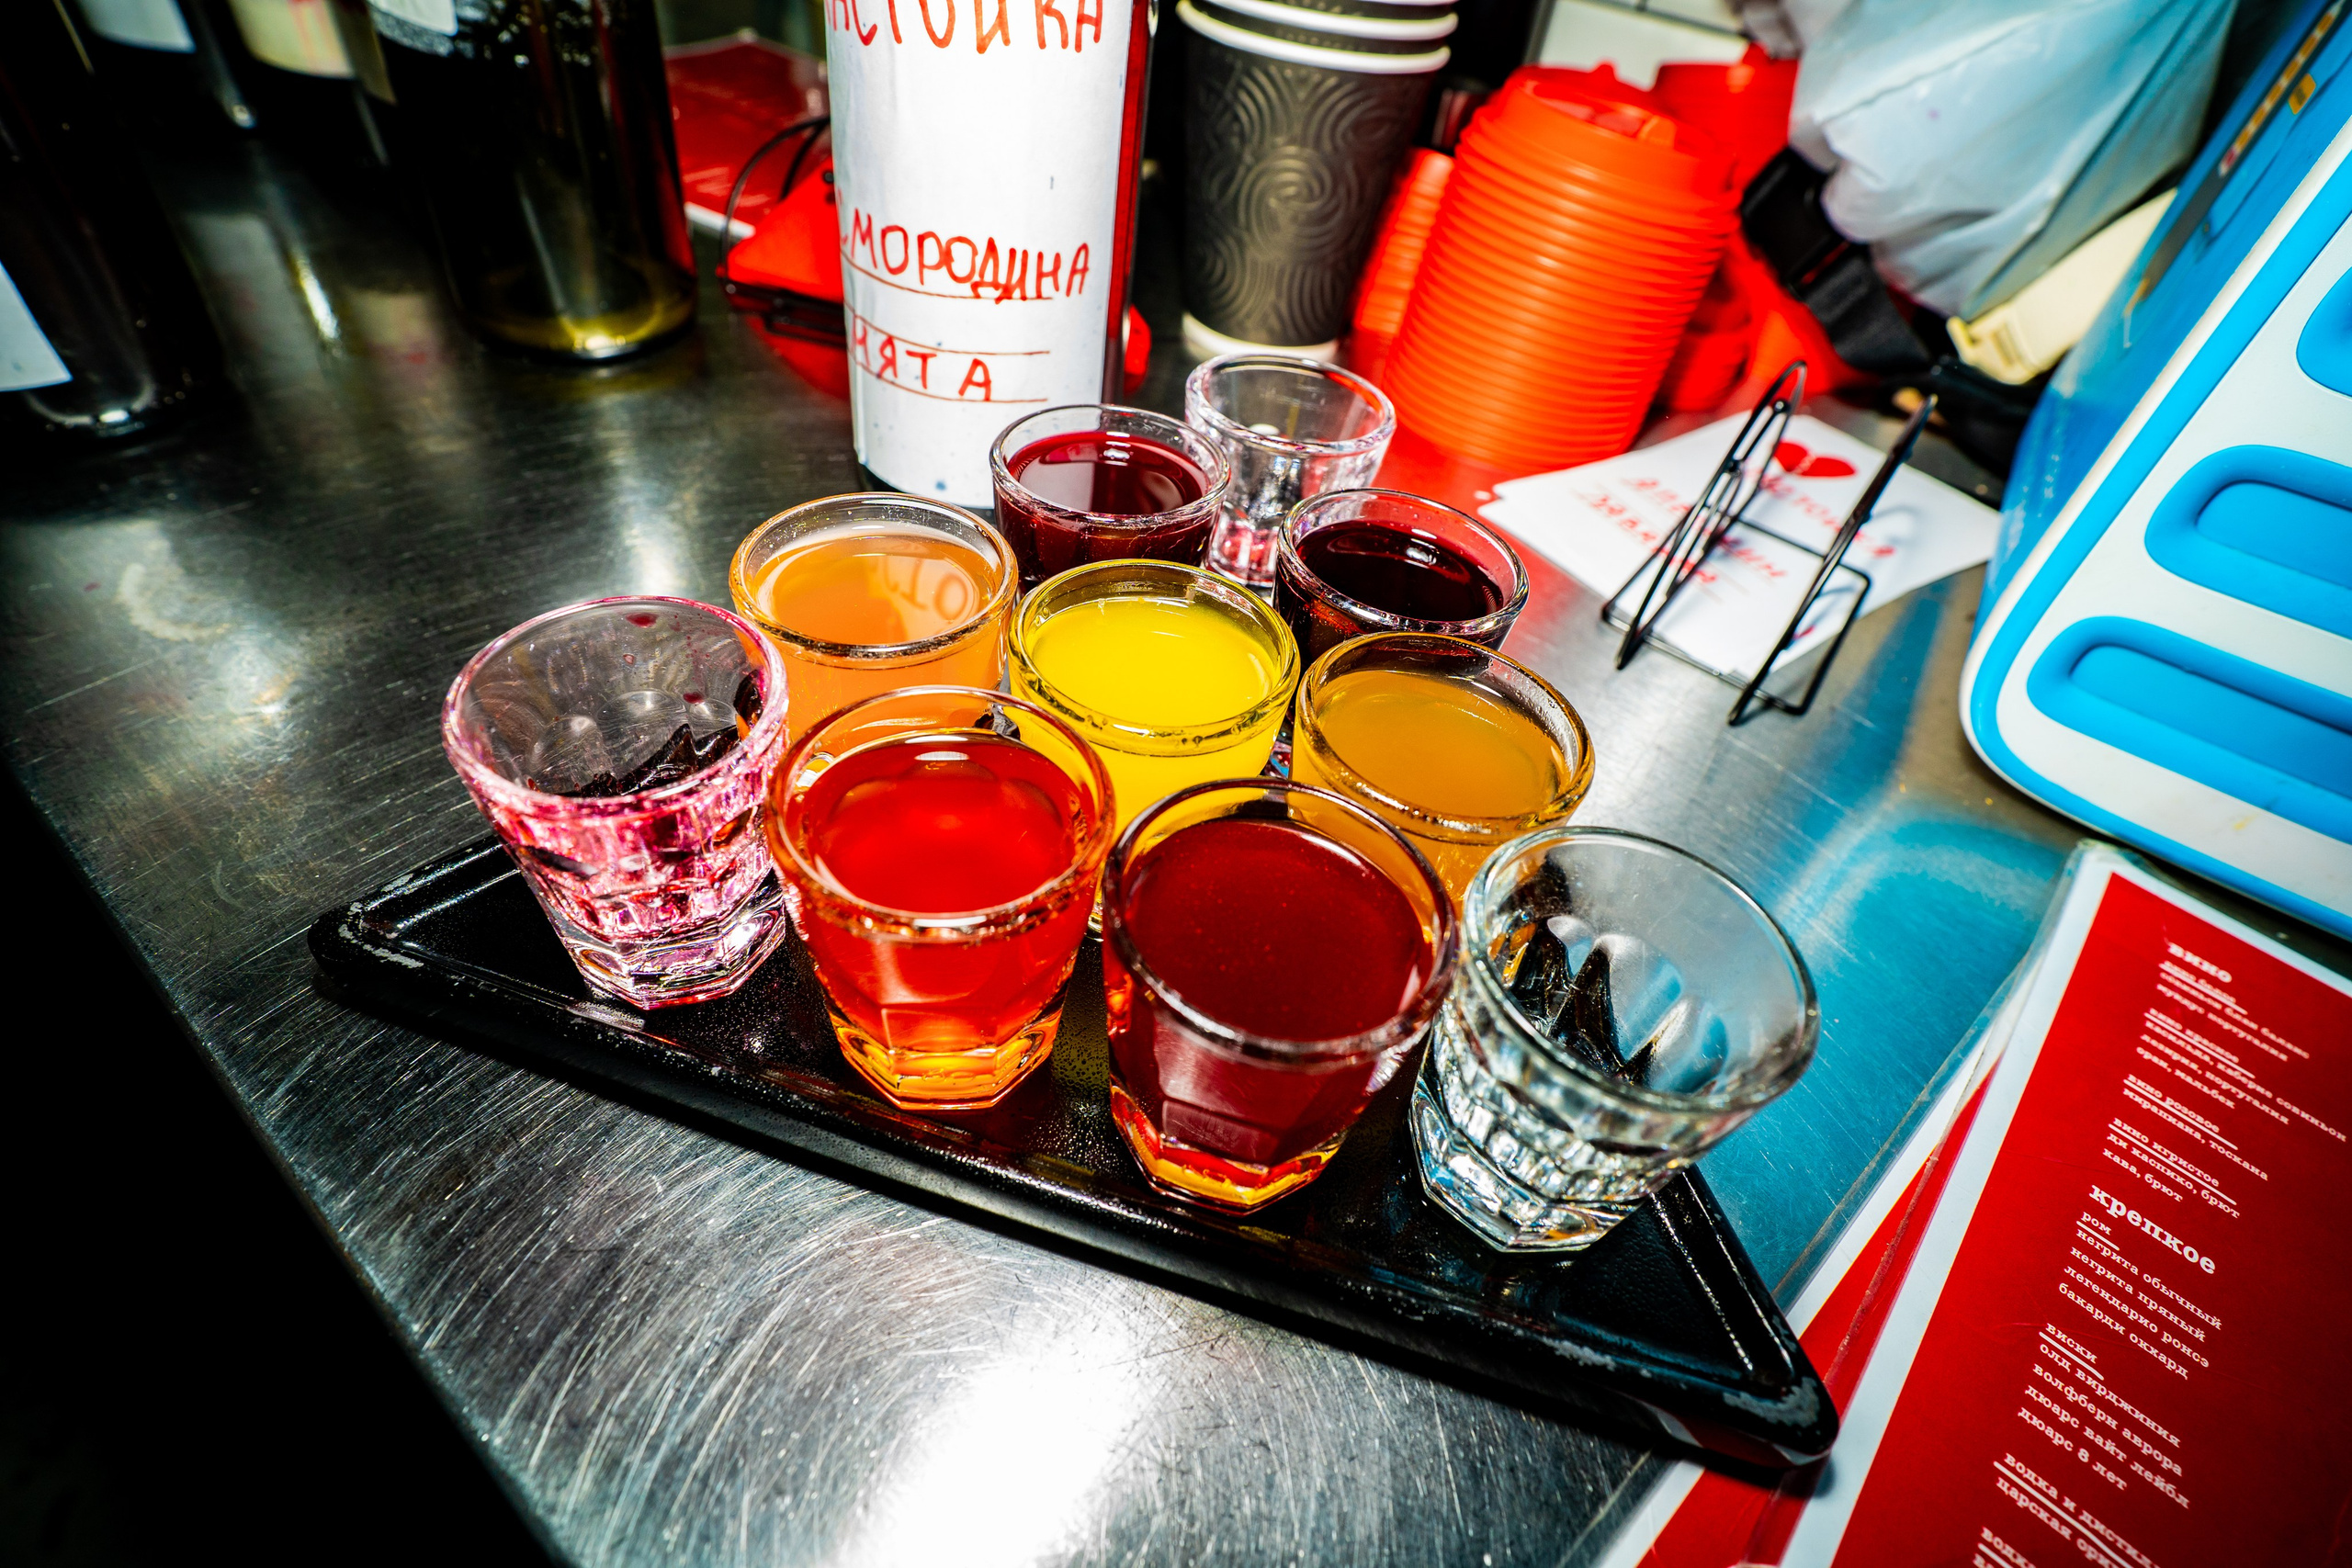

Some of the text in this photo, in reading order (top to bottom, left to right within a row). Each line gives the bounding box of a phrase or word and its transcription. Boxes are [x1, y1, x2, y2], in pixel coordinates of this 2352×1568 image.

[2168, 942, 2233, 983] вино
[2149, 1008, 2182, 1030] вино
[2128, 1074, 2221, 1134] вино розовое
[2174, 1069, 2235, 1109] мальбек
[2205, 1071, 2290, 1124] португалия
[2216, 1063, 2273, 1099] каберне
[2276, 1098, 2347, 1142] совиньон
[2102, 1148, 2183, 1202] кава, брют
[2107, 1133, 2241, 1219] ди каспико, брют
[2113, 1117, 2220, 1188] вино игристое
[2209, 1140, 2268, 1181] тоскана
[2080, 1211, 2112, 1235] ром
[2088, 1184, 2216, 1275] крепкое
[2070, 1247, 2206, 1343] негрита пряный
[2075, 1228, 2222, 1331] негрита обычный
[2045, 1323, 2098, 1364] виски
[2058, 1282, 2188, 1381] бакарди окхард
[2064, 1266, 2210, 1368] легендарио ронсэ
[2032, 1363, 2183, 1477] волфберн аврора
[2040, 1343, 2181, 1449] олд вирджиния
[2004, 1452, 2059, 1500] водка
[2062, 1495, 2077, 1513] и
[2018, 1406, 2128, 1491] дюарс 8 лет
[2024, 1385, 2191, 1509] дюарс вайт лейбл
[1996, 1476, 2073, 1540] царская
